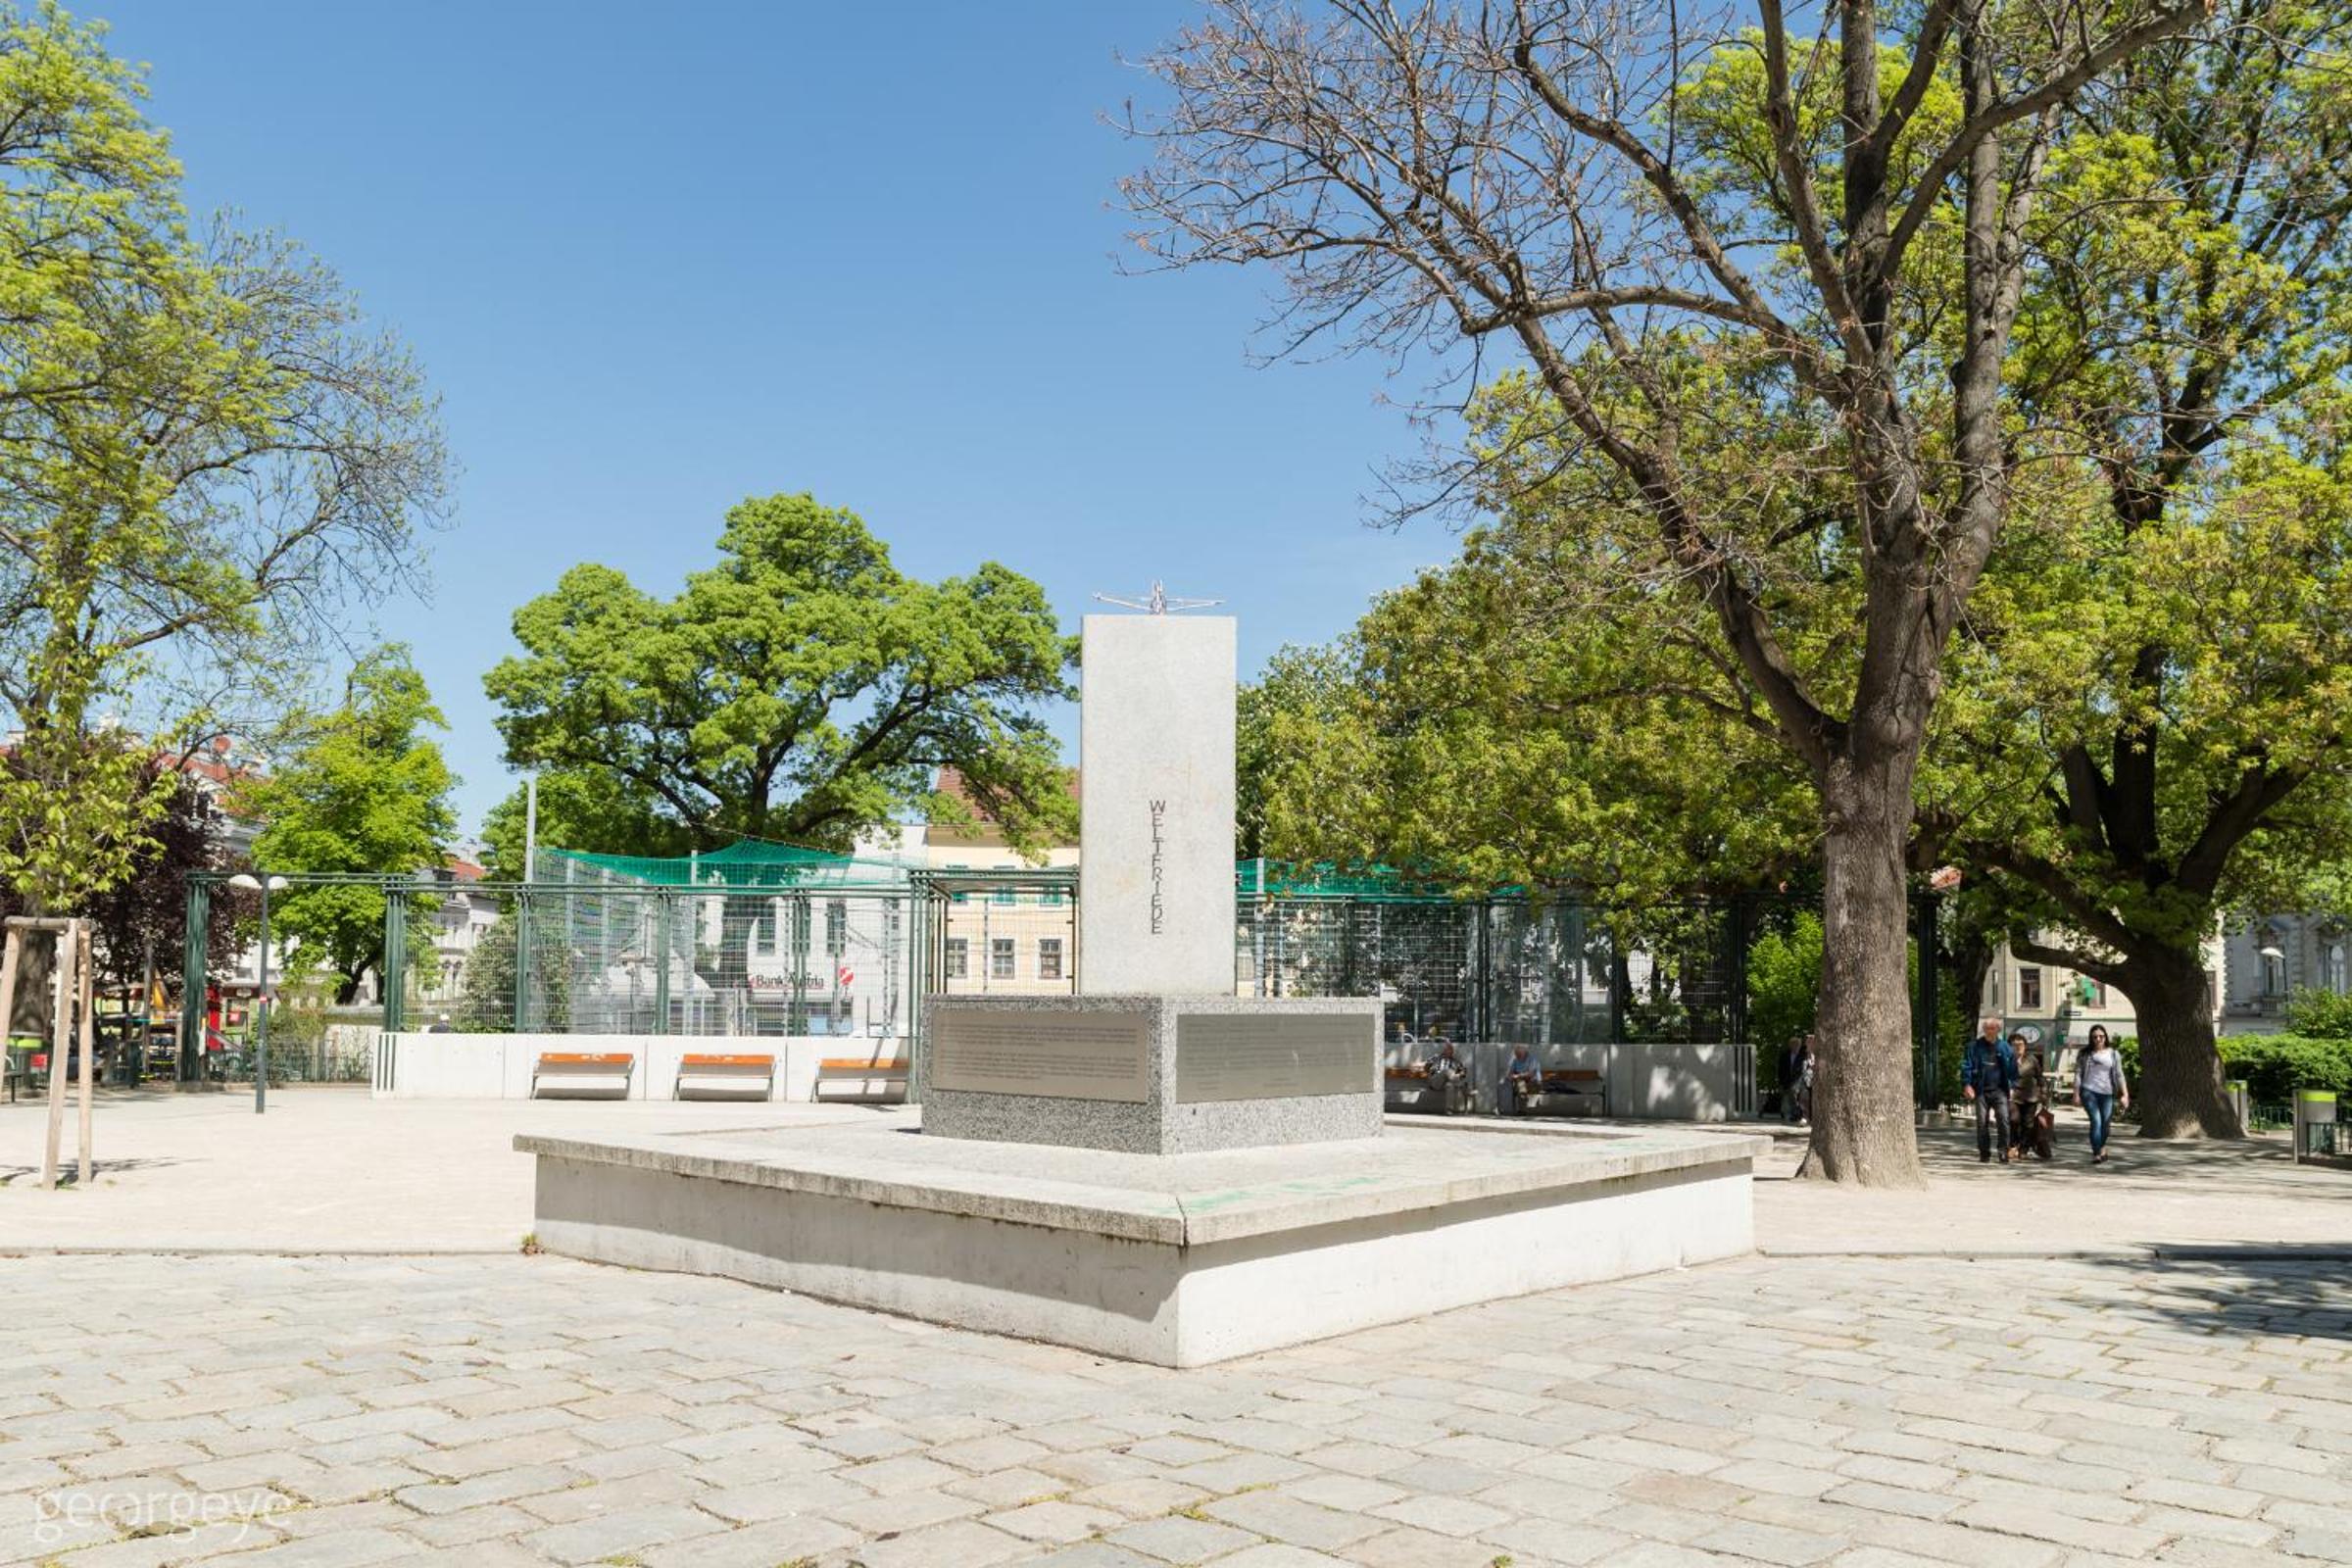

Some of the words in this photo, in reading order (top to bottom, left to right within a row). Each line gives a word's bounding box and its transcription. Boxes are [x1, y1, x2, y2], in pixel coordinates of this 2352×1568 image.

[1149, 799, 1166, 935] WELTFRIEDE
[756, 973, 783, 988] Bank
[787, 972, 824, 988] Atria
